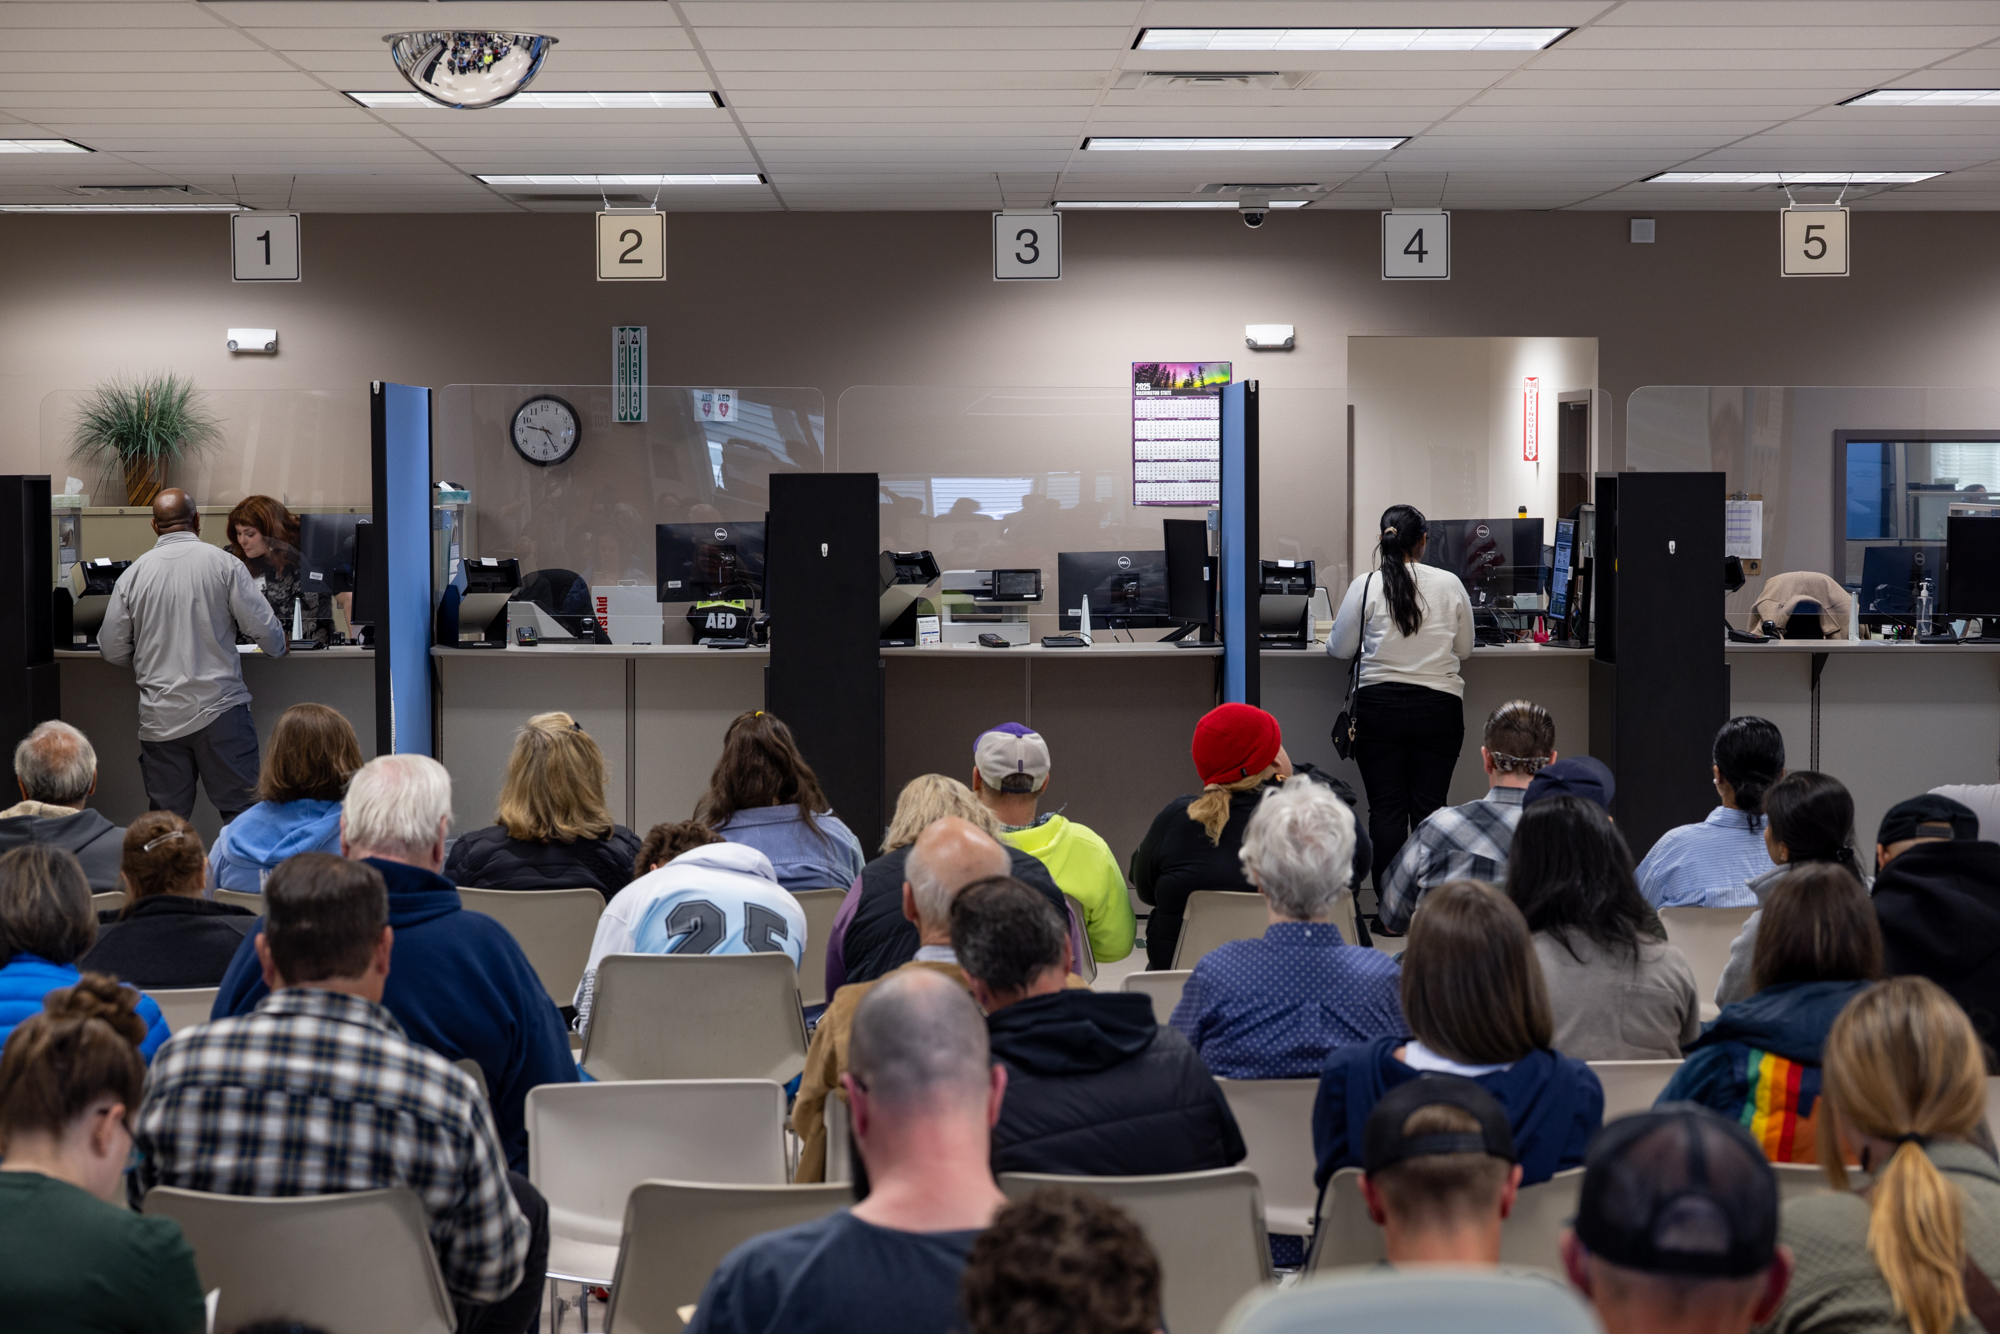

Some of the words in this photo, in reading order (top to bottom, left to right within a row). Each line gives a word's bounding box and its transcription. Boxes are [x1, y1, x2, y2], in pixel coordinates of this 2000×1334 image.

[257, 230, 270, 265] 1
[619, 229, 642, 264] 2
[1016, 229, 1039, 264] 3
[1403, 229, 1428, 263] 4
[1803, 224, 1828, 260] 5
[1135, 382, 1151, 391] 2025
[701, 394, 712, 402] AED
[717, 394, 730, 402] AED
[540, 404, 549, 412] 12
[523, 416, 531, 424] 10
[543, 448, 548, 456] 6
[596, 596, 608, 614] Aid
[705, 613, 737, 630] AED
[665, 899, 788, 955] 25
